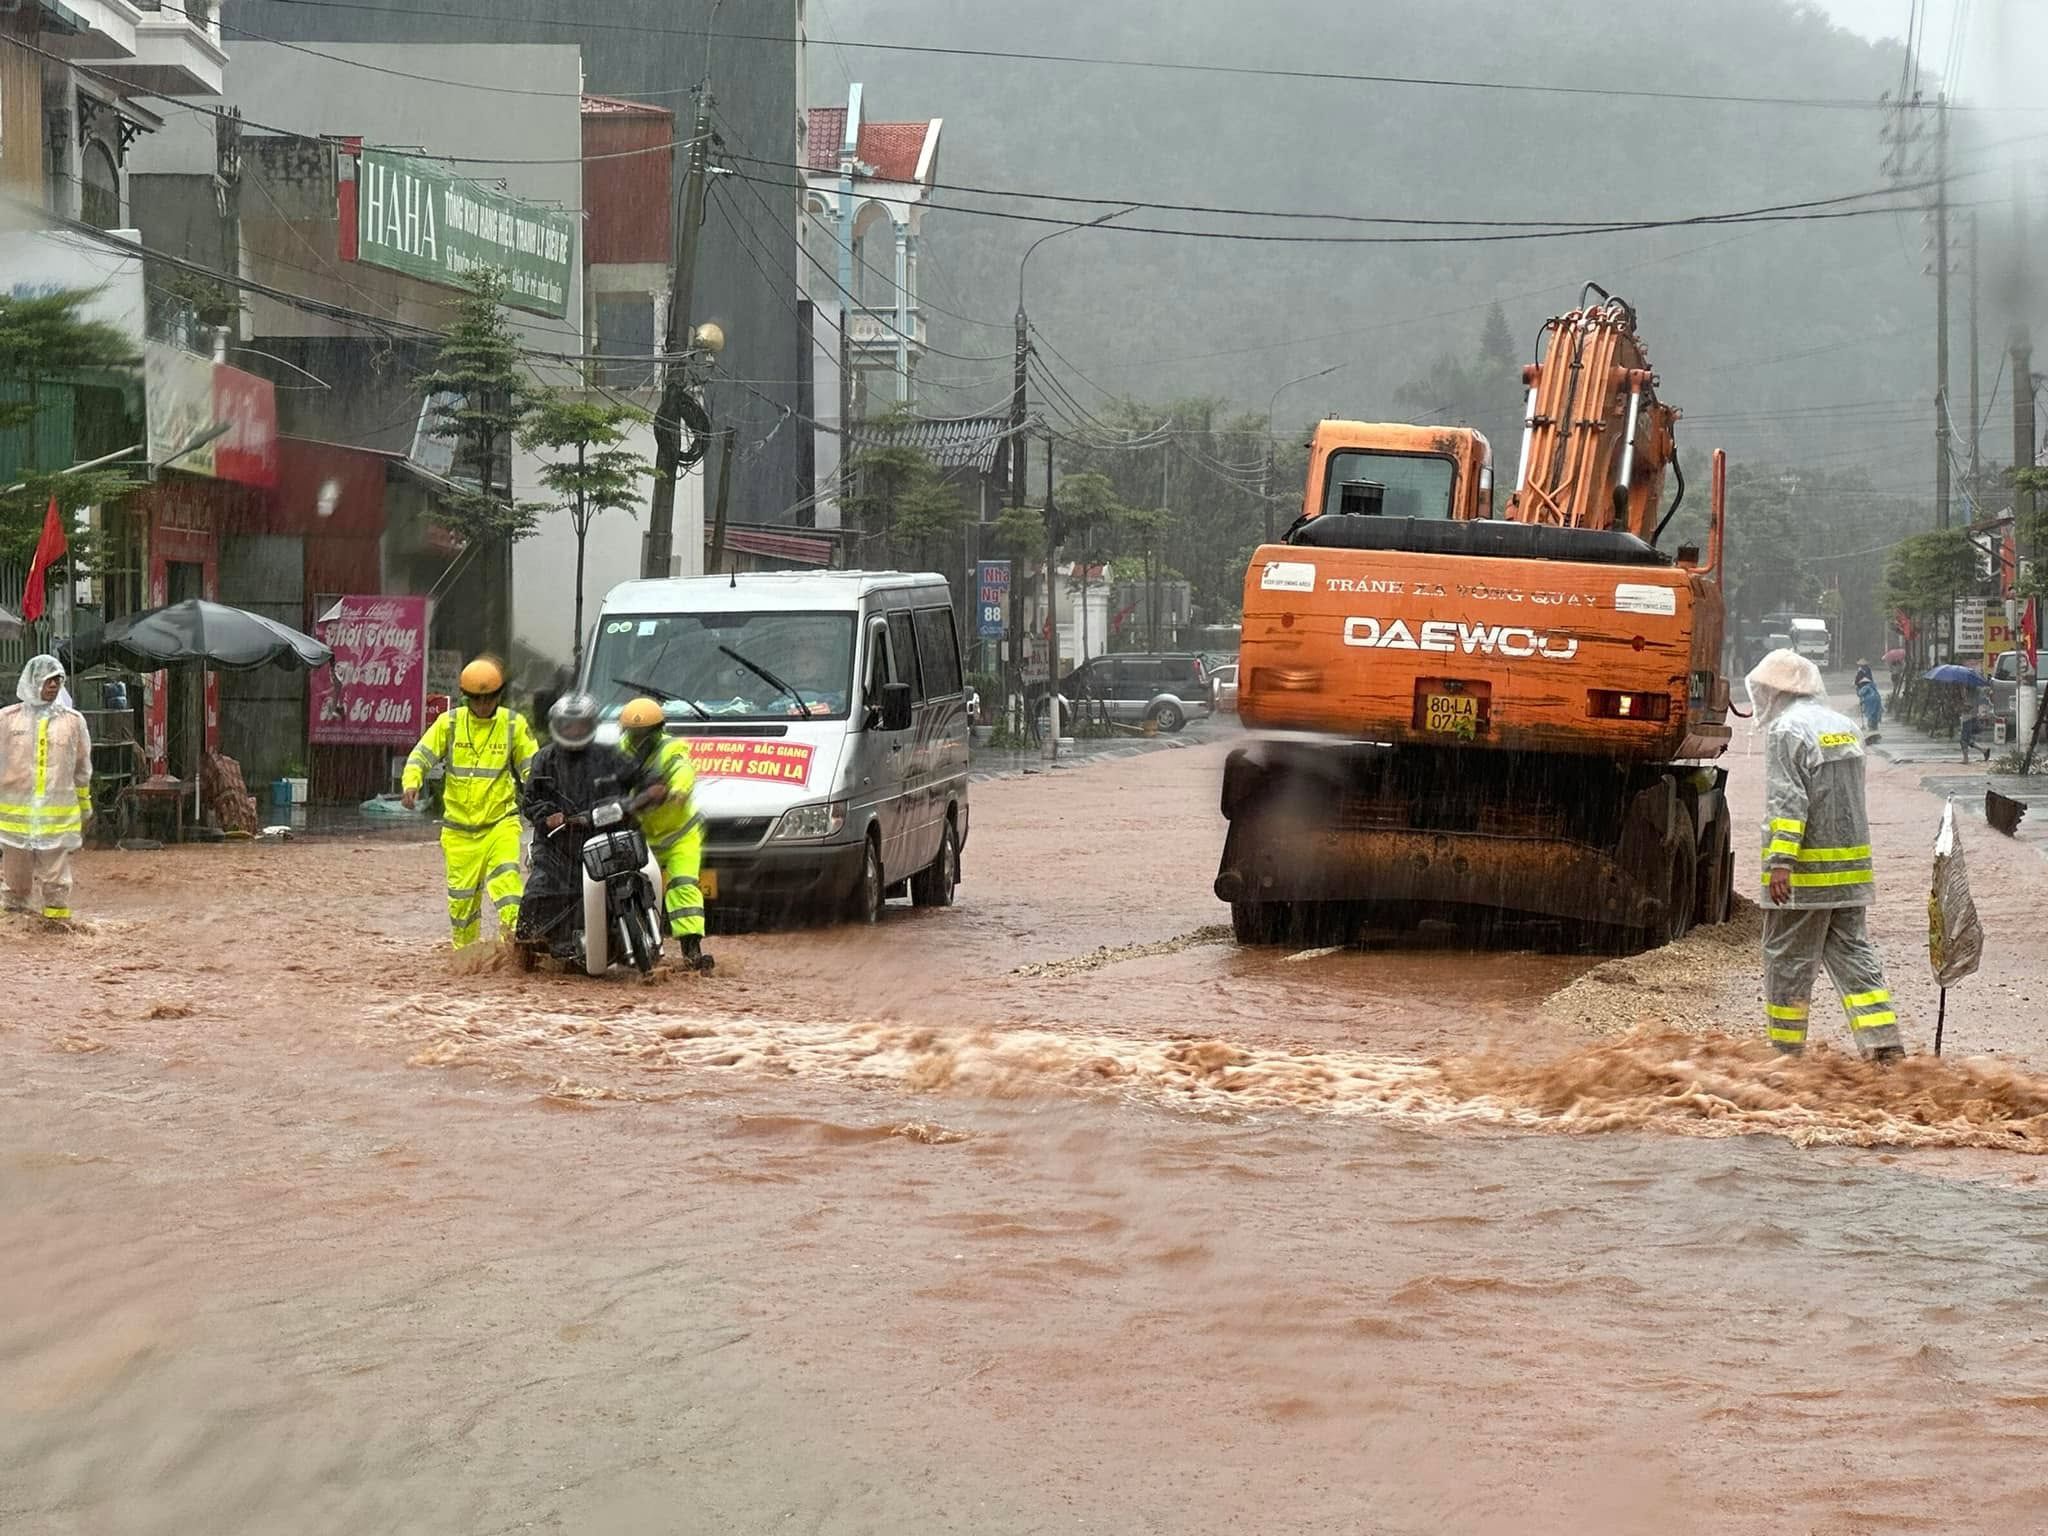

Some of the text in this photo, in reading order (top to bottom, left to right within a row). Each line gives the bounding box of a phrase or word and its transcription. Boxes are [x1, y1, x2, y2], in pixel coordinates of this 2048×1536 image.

[367, 162, 437, 261] HAHA
[1326, 576, 1405, 594] TRÁNH
[984, 607, 1001, 621] 88
[1343, 616, 1579, 659] DAEWOO
[777, 746, 808, 759] GIANG
[747, 759, 781, 777] SƠN
[784, 762, 803, 779] LA
